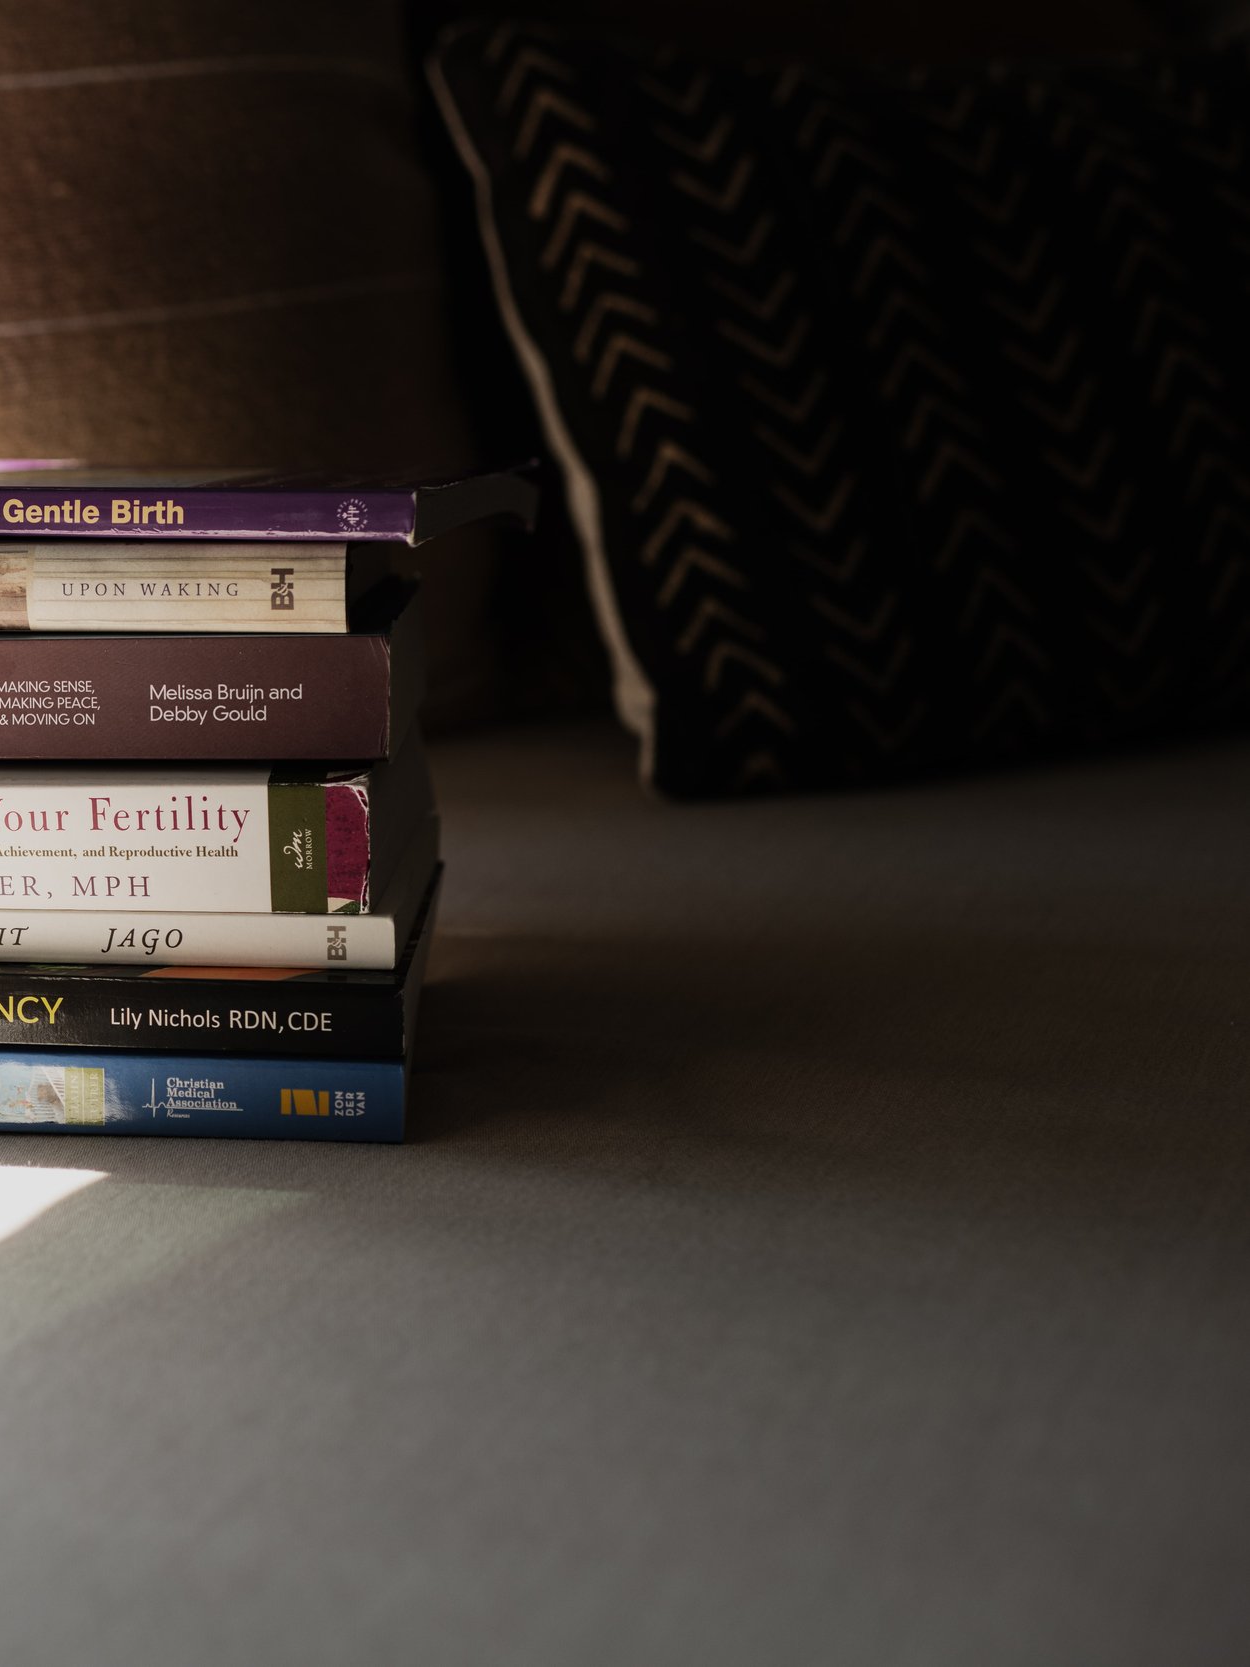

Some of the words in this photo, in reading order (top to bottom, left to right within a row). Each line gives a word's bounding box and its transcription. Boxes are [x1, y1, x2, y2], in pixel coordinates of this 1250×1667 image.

[2, 499, 100, 525] Gentle
[111, 500, 184, 525] Birth
[61, 582, 126, 597] UPON
[140, 582, 240, 597] WAKING
[53, 681, 95, 695] SENSE,
[150, 684, 212, 700] Melissa
[217, 684, 264, 703] Bruijn
[269, 684, 303, 700] and
[0, 697, 54, 709] MAKING
[57, 697, 100, 711] PEACE,
[0, 714, 9, 726] &
[12, 714, 70, 725] MOVING
[73, 714, 95, 725] ON
[150, 706, 207, 725] Debby
[213, 706, 267, 722] Gould
[88, 796, 250, 842] Fertility
[83, 846, 105, 857] and
[109, 846, 192, 860] Reproductive
[196, 846, 238, 857] Health
[305, 829, 313, 870] MORROW
[72, 875, 151, 897] MPH
[101, 928, 184, 954] JAGO
[110, 1007, 142, 1030] Lily
[149, 1009, 221, 1029] Nichols
[167, 1077, 224, 1089] Christian
[167, 1088, 215, 1098] Medical
[167, 1098, 237, 1109] Association
[335, 1091, 344, 1116] ZON
[346, 1092, 355, 1116] DER
[356, 1092, 366, 1116] VAN
